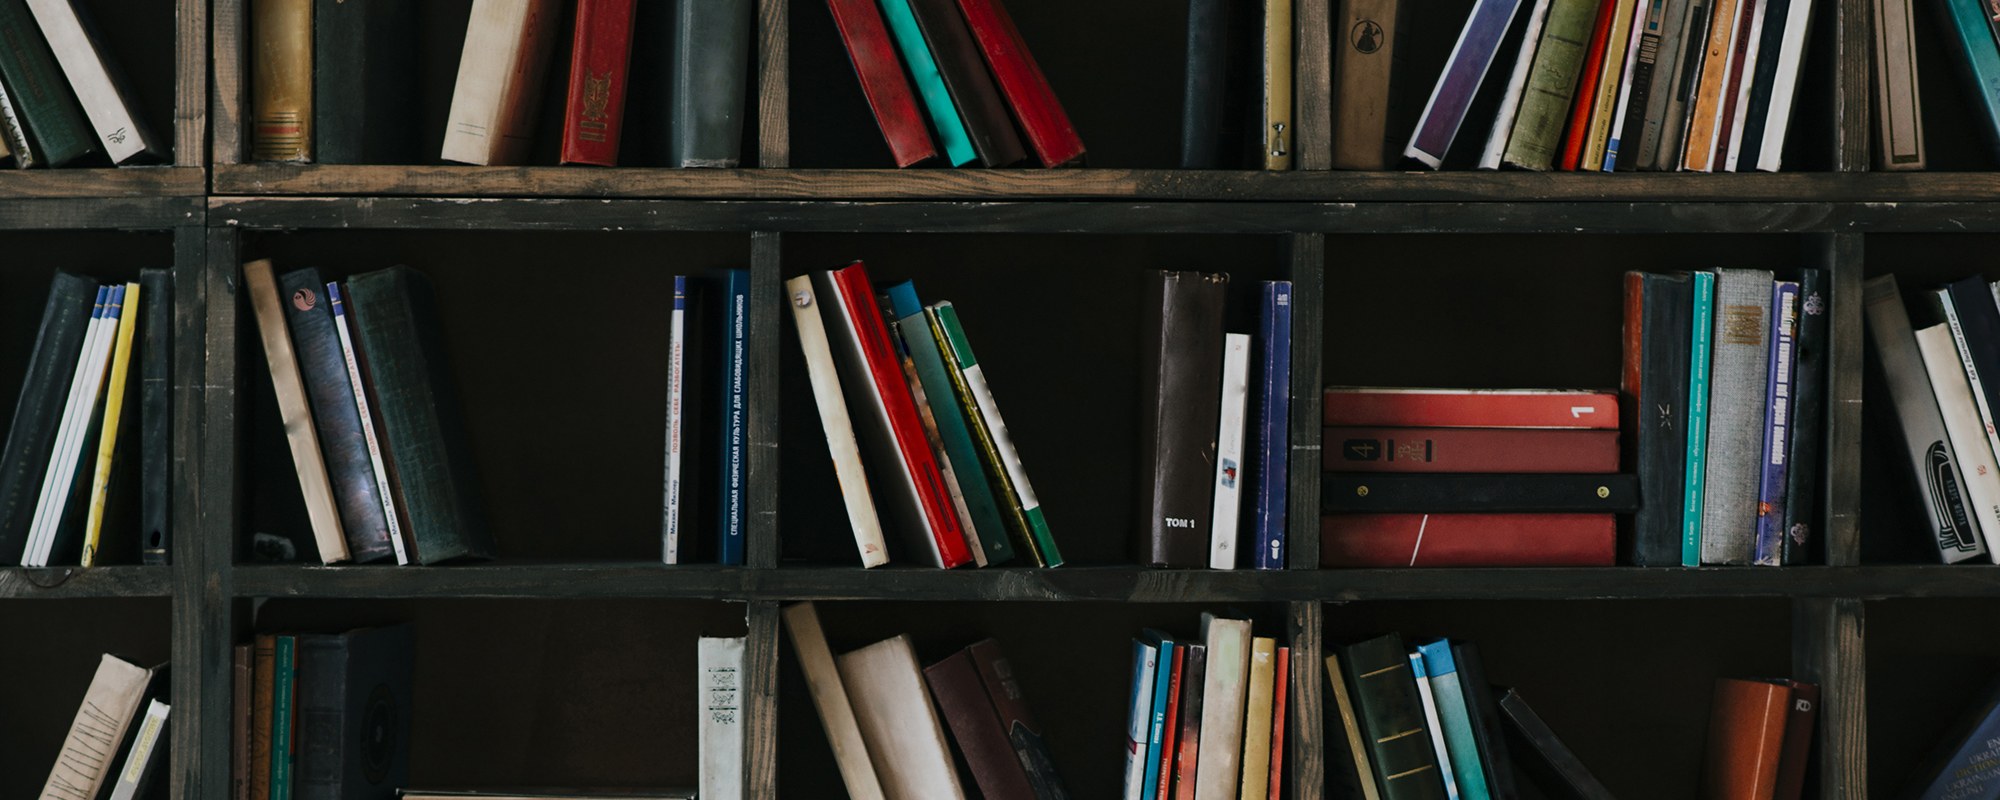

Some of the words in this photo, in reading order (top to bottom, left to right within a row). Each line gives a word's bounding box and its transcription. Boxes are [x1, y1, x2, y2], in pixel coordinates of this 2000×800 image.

[735, 294, 743, 338] ШКОЛЬНИКОВ
[673, 341, 681, 392] РАЗБОГАТЕТЬ!
[734, 340, 743, 393] СЛАБОВИДЯЩИХ
[358, 400, 368, 418] СЕБЕ
[733, 394, 741, 408] ДЛЯ
[1571, 406, 1595, 418] 1
[364, 422, 378, 455] ПОЗВОЛЬ
[732, 410, 740, 444] КУЛЬТУРА
[731, 446, 740, 488] ФИЗИЧЕСКАЯ
[379, 480, 391, 506] Миллер
[670, 479, 678, 504] Миллер
[730, 489, 739, 535] СПЕЦИАЛЬНАЯ
[1166, 518, 1188, 528] ТОМ
[1190, 519, 1195, 528] 1
